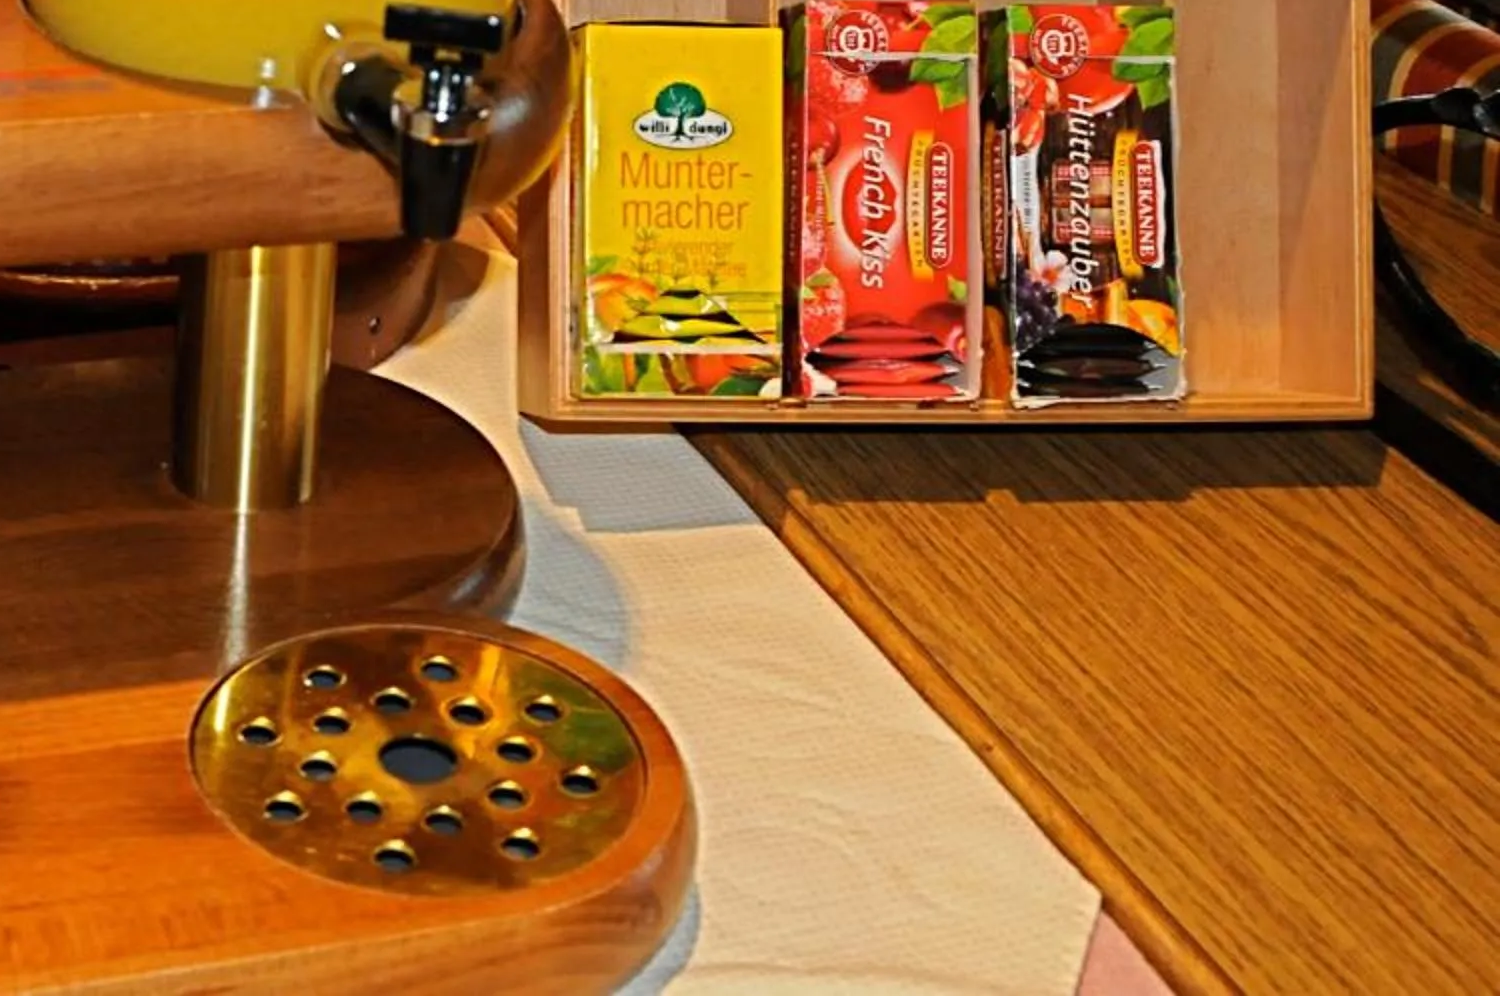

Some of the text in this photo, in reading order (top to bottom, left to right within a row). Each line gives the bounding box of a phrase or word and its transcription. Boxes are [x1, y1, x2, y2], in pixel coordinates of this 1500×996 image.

[619, 151, 753, 190] Munter-
[639, 120, 669, 133] willi
[622, 193, 750, 231] macher
[862, 114, 892, 290] French Kiss
[931, 150, 948, 261] TEEKANNE
[1066, 93, 1095, 310] Hüttenzauber
[1134, 149, 1154, 258] TEEKANNE
